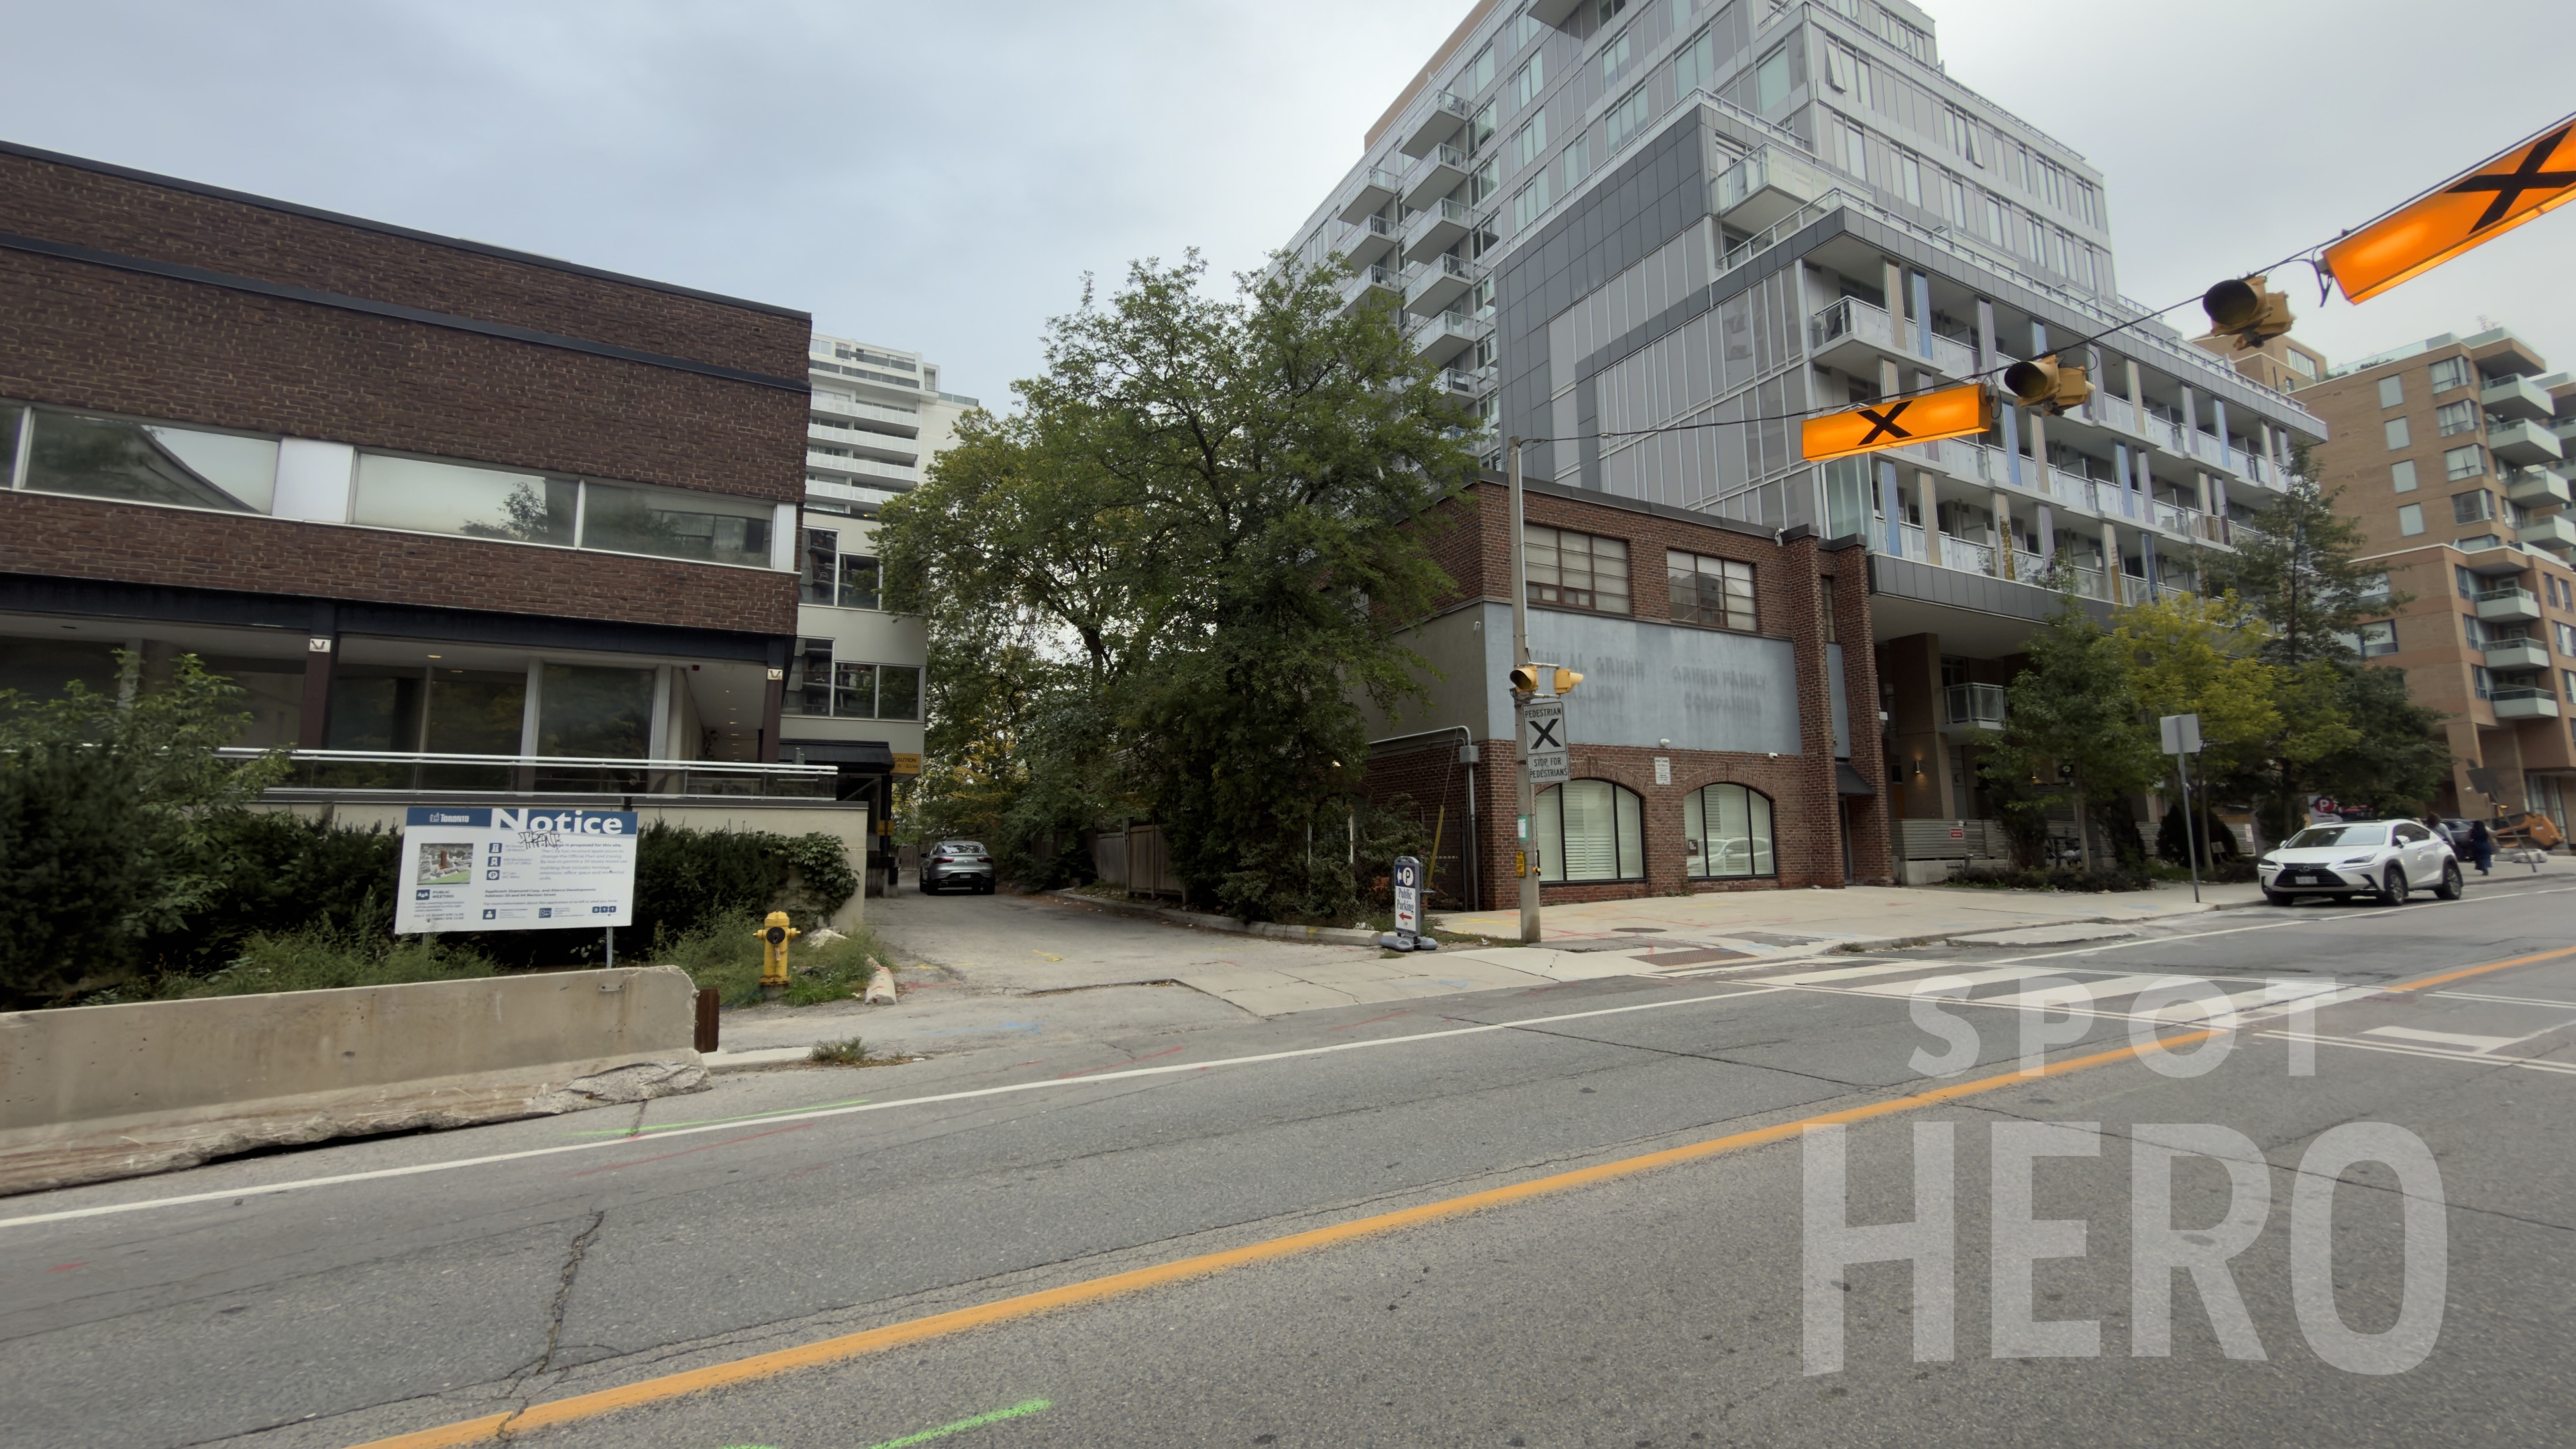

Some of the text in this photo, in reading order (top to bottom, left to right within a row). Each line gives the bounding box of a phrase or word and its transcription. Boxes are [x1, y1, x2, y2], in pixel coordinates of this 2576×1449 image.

[1525, 708, 1562, 718] PEDESTRIAN
[1534, 757, 1562, 767] STOP FOR
[1529, 768, 1568, 778] PEDESTRIANS
[2320, 800, 2329, 812] P
[440, 808, 623, 834] TORONTO Notice
[1405, 869, 1410, 884] P
[1399, 888, 1412, 900] Public
[1397, 899, 1413, 915] Parking
